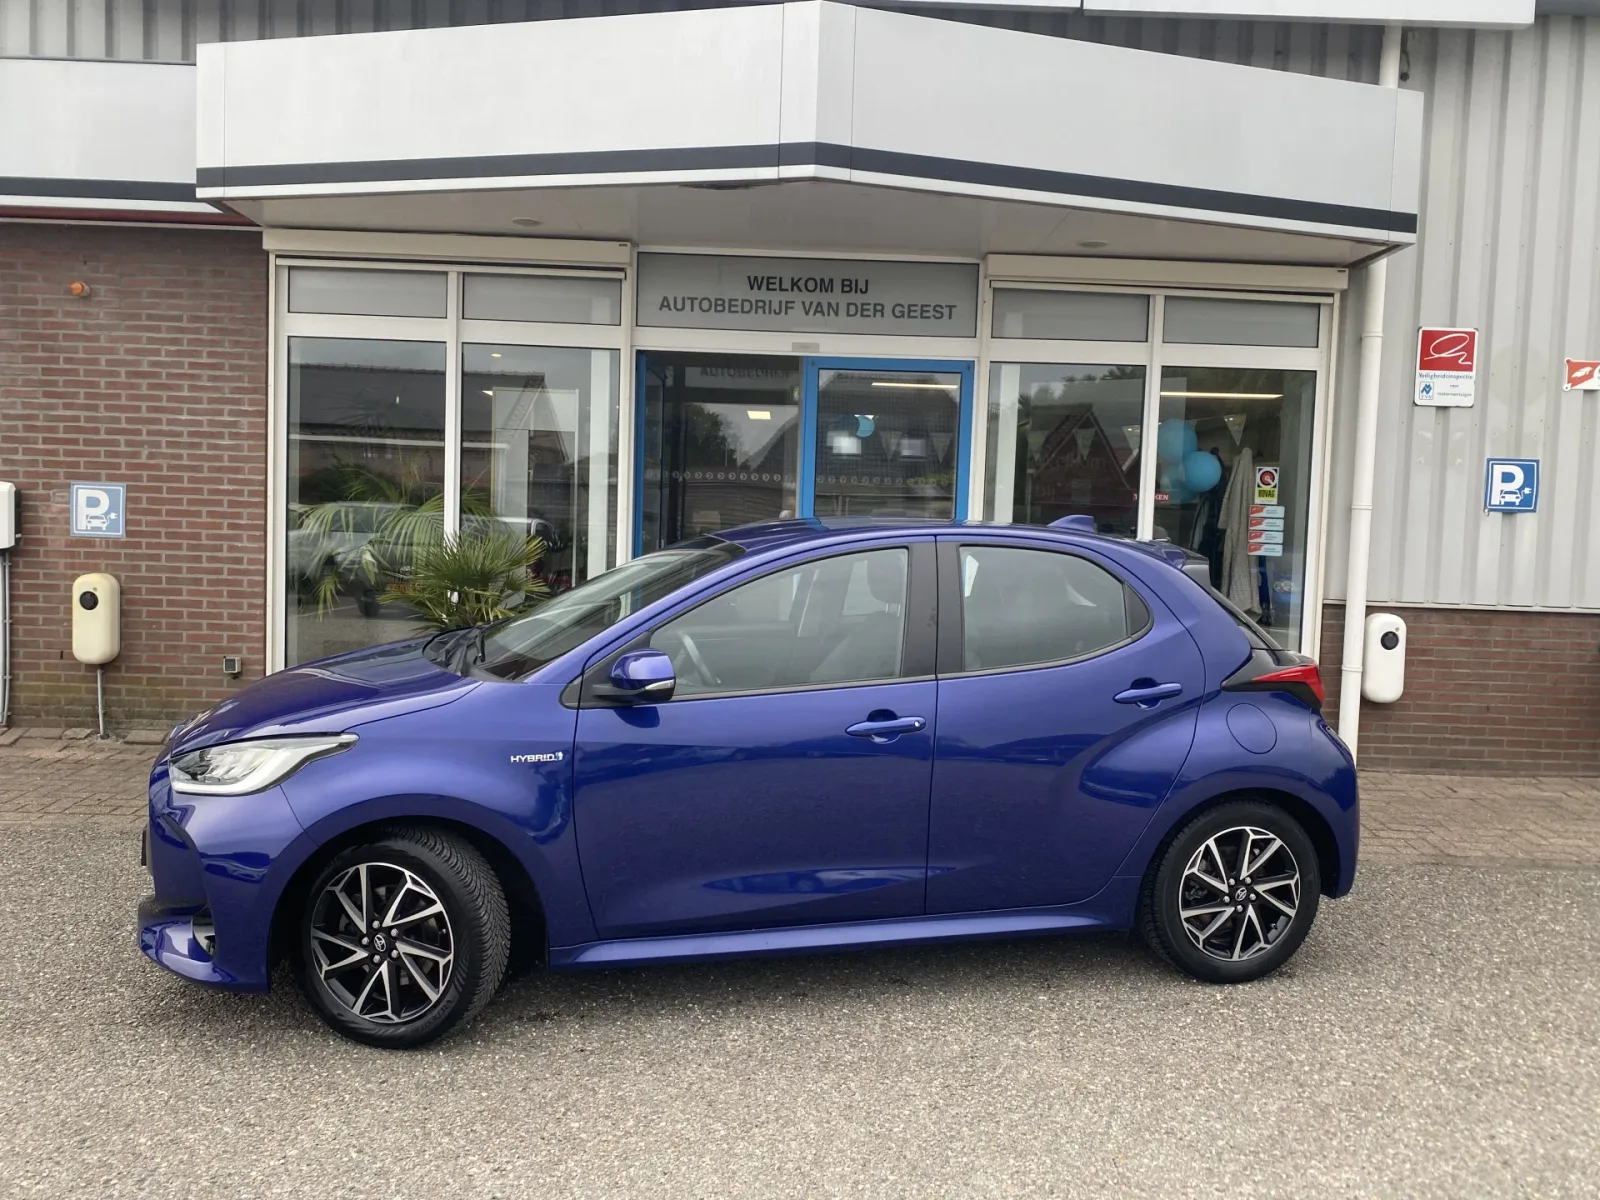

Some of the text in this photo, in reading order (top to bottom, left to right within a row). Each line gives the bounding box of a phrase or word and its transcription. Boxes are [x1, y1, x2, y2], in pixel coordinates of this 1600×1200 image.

[747, 275, 869, 295] WELKOM BIJ
[659, 296, 957, 320] AUTOBEDRIJF VAN DER GEEST
[1490, 464, 1524, 505] P
[77, 488, 109, 530] P
[510, 753, 555, 763] HYBRID
